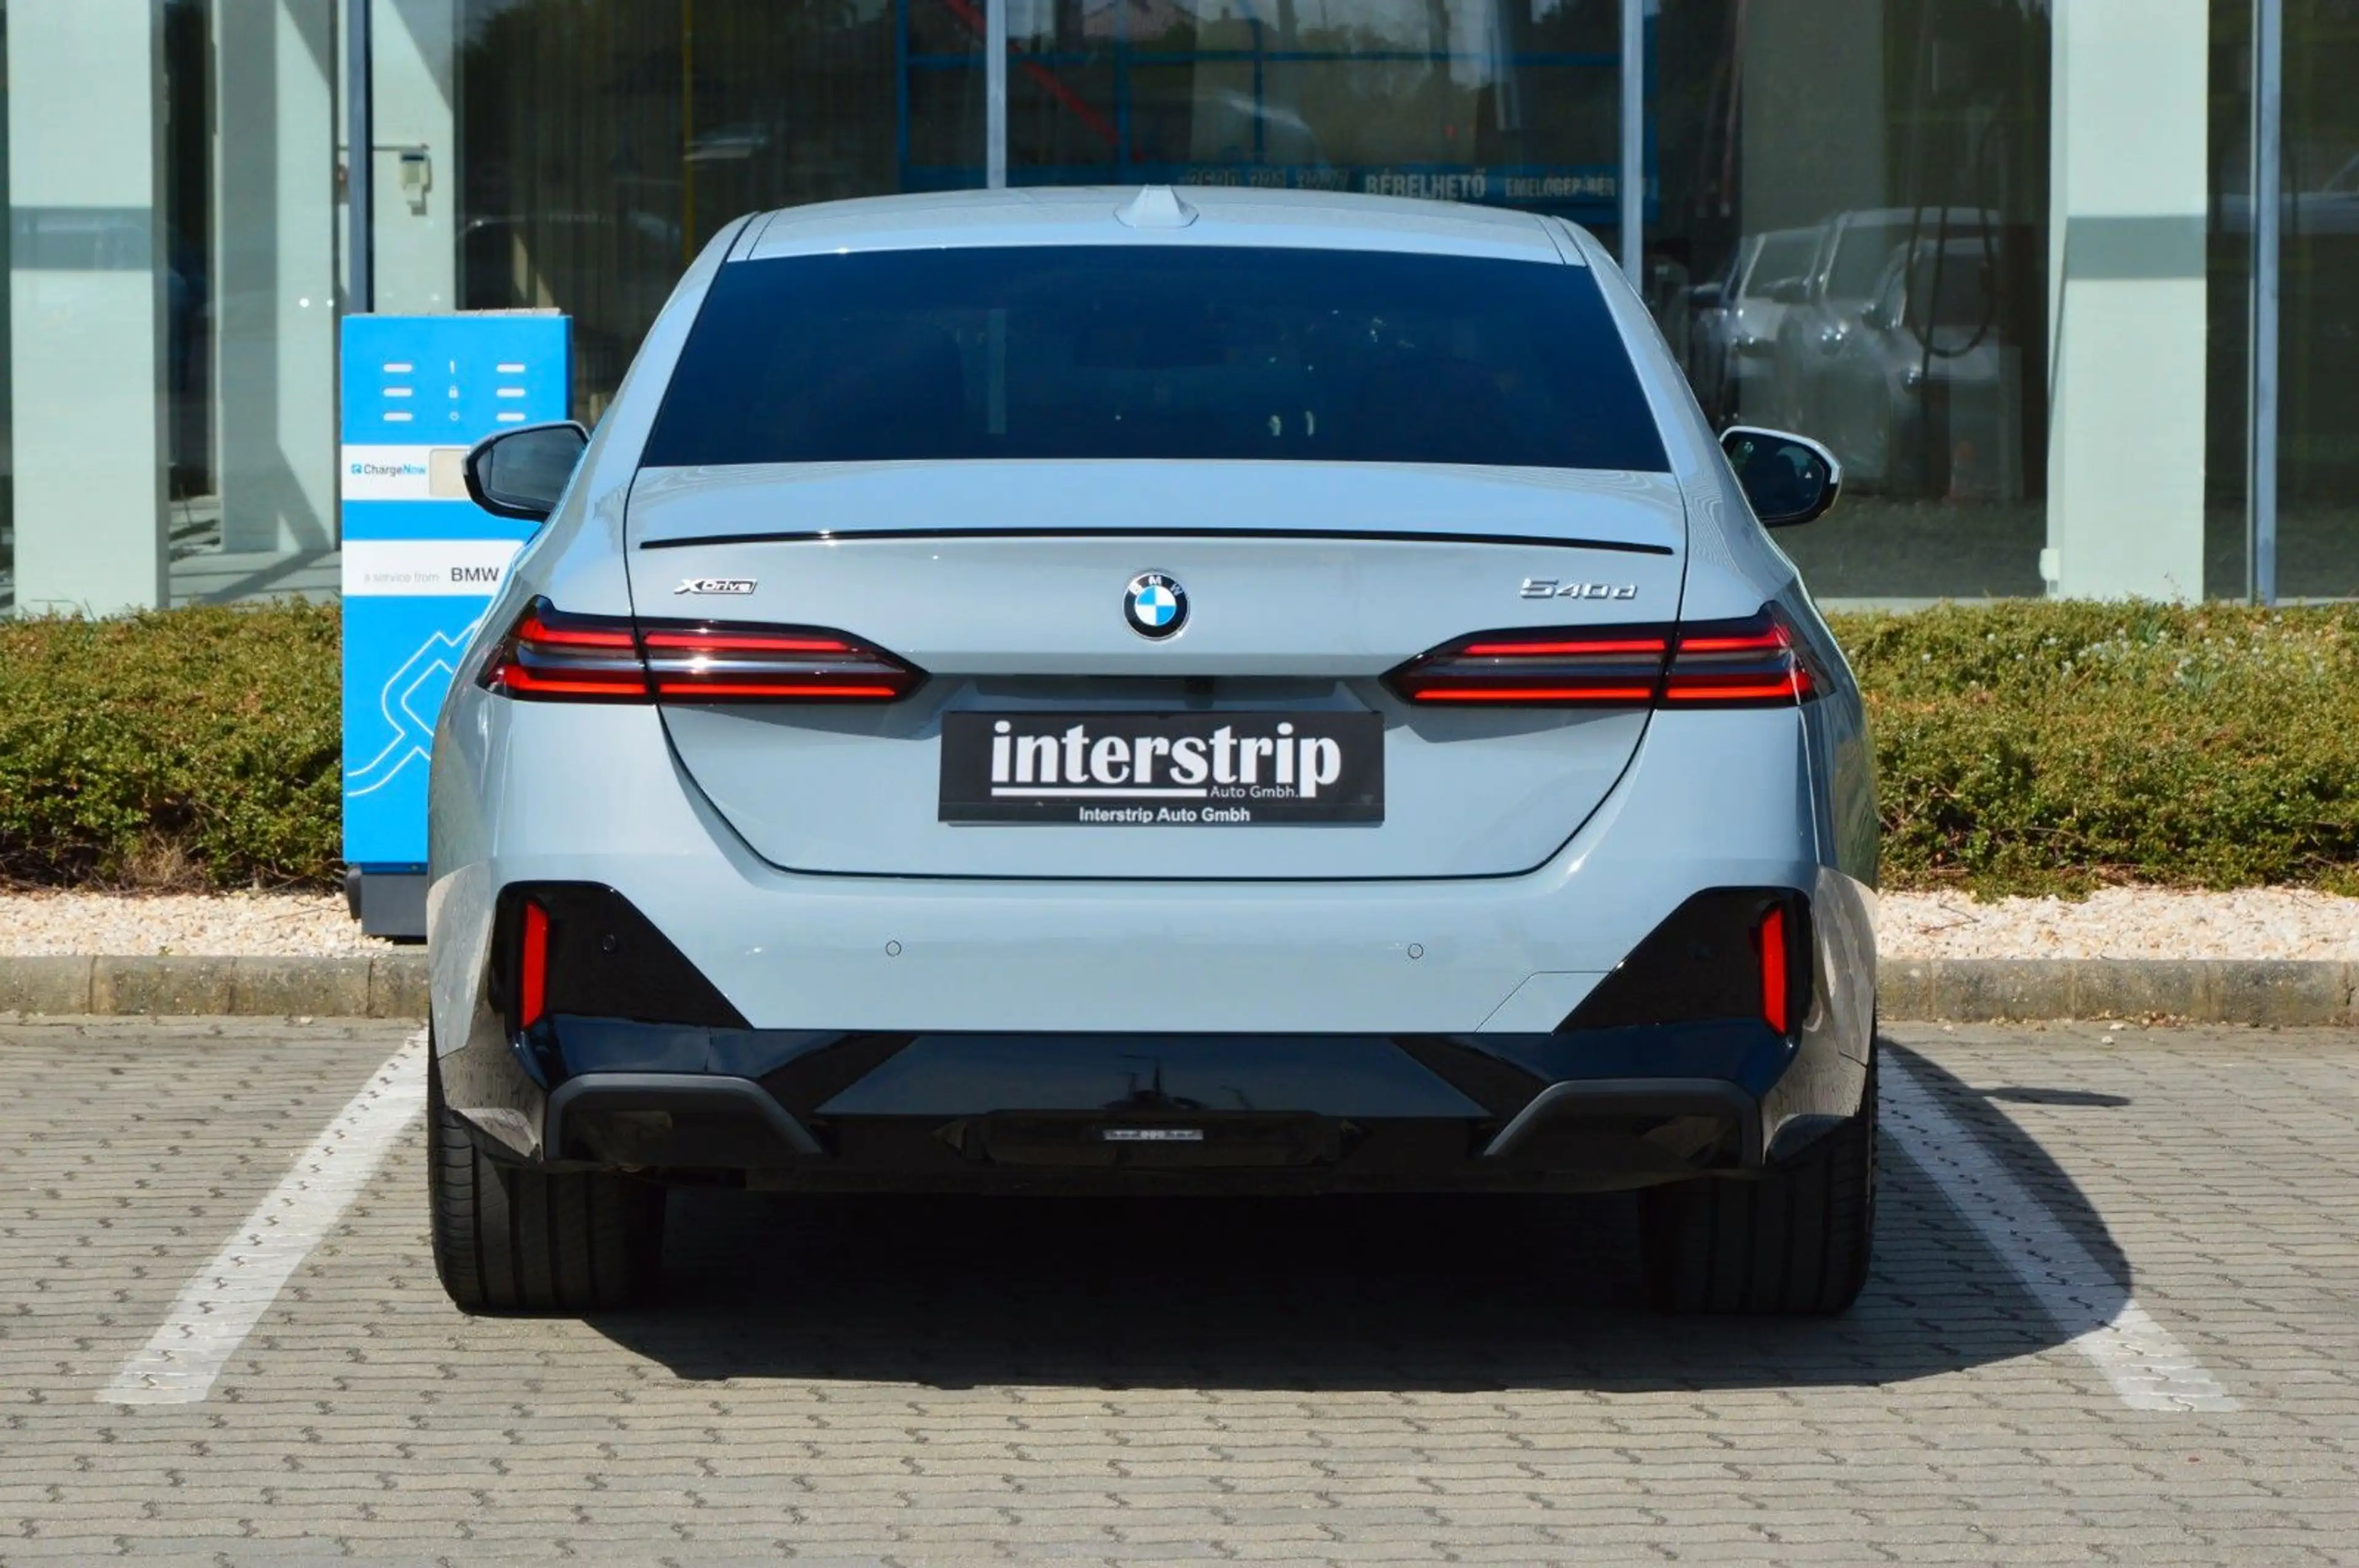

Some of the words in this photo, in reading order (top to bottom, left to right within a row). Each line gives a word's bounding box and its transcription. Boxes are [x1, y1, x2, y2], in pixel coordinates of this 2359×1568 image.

[364, 464, 426, 477] ChargeNow
[373, 572, 411, 583] service
[415, 572, 439, 583] from
[451, 567, 499, 582] BMW
[1520, 578, 1637, 599] 540d
[992, 720, 1341, 798] interstrip
[1210, 786, 1245, 798] Auto
[1079, 806, 1153, 823] Interstrip
[1157, 808, 1197, 822] Auto
[1201, 807, 1250, 822] Gmbh
